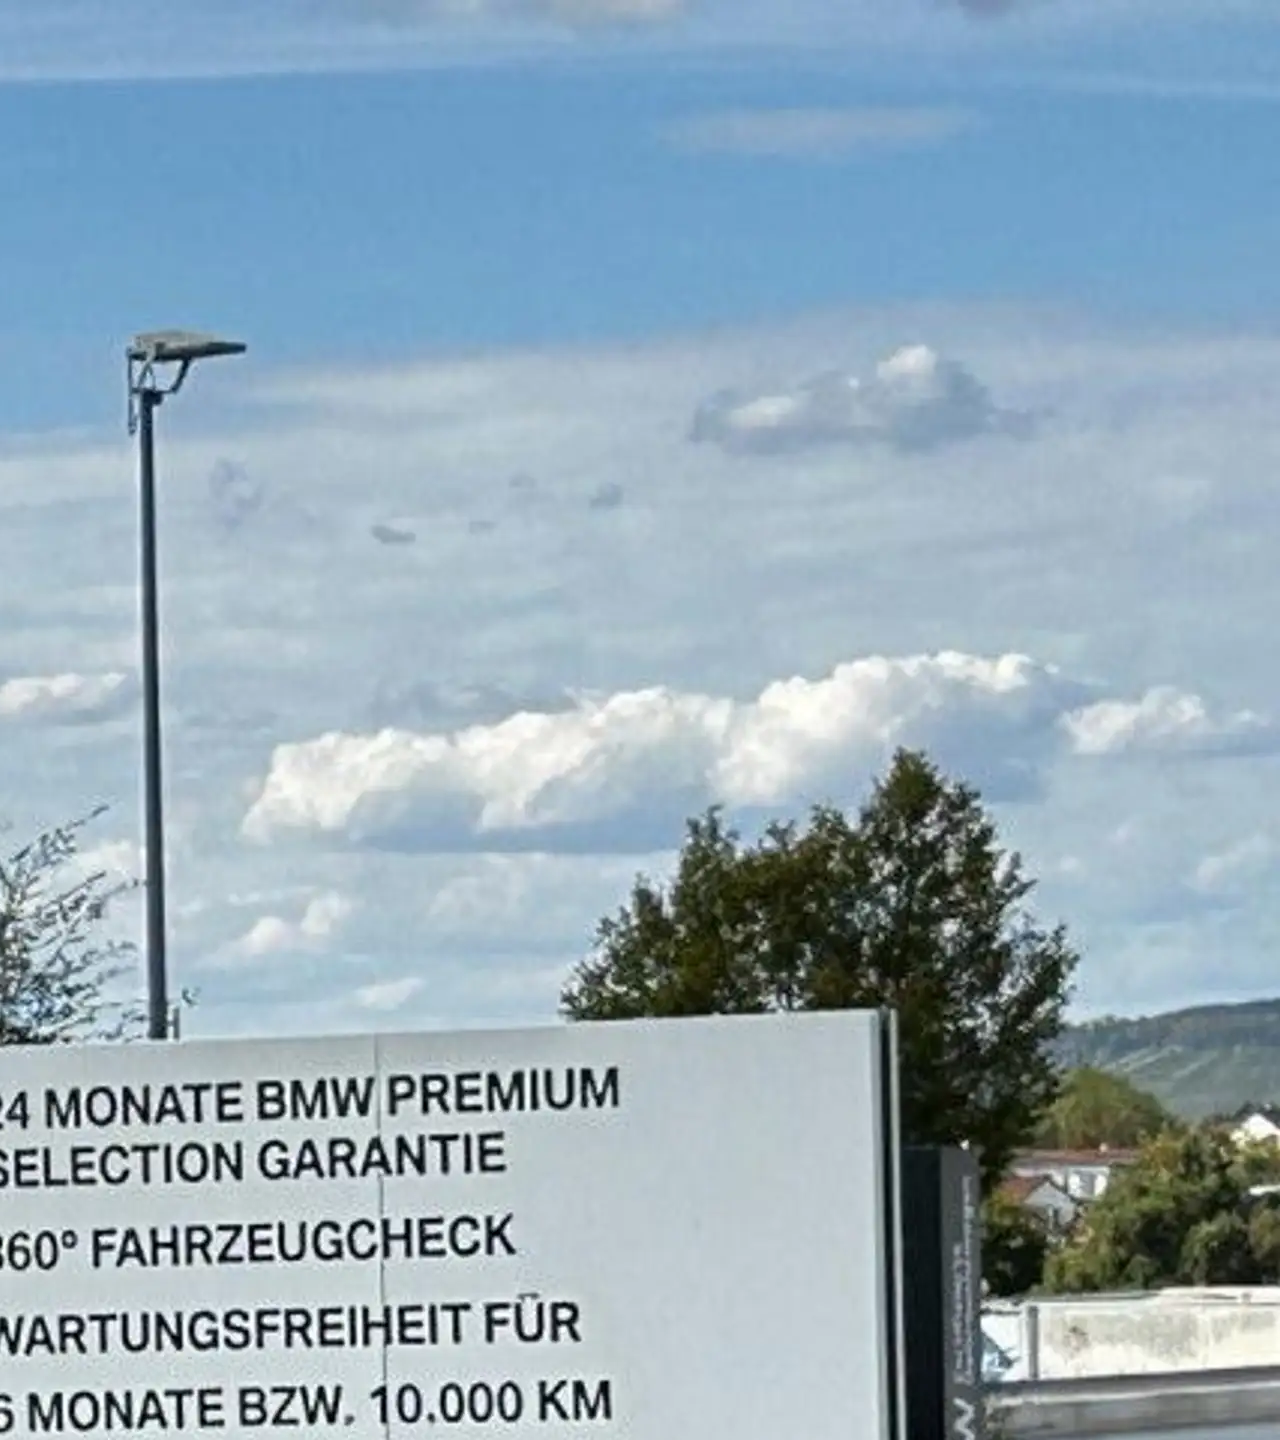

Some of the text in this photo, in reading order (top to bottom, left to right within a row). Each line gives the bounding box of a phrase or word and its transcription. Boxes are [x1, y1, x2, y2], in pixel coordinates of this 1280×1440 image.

[44, 1081, 244, 1129] MONATE
[257, 1076, 376, 1121] BMW
[388, 1067, 620, 1115] PREMIUM
[258, 1131, 507, 1179] GARANTIE
[92, 1213, 516, 1268] FAHRZEUGCHECK
[485, 1293, 581, 1343] FÜR
[27, 1388, 225, 1432] MONATE
[239, 1385, 355, 1427] BZW.
[370, 1381, 523, 1424] 10.000
[538, 1379, 613, 1421] KM
